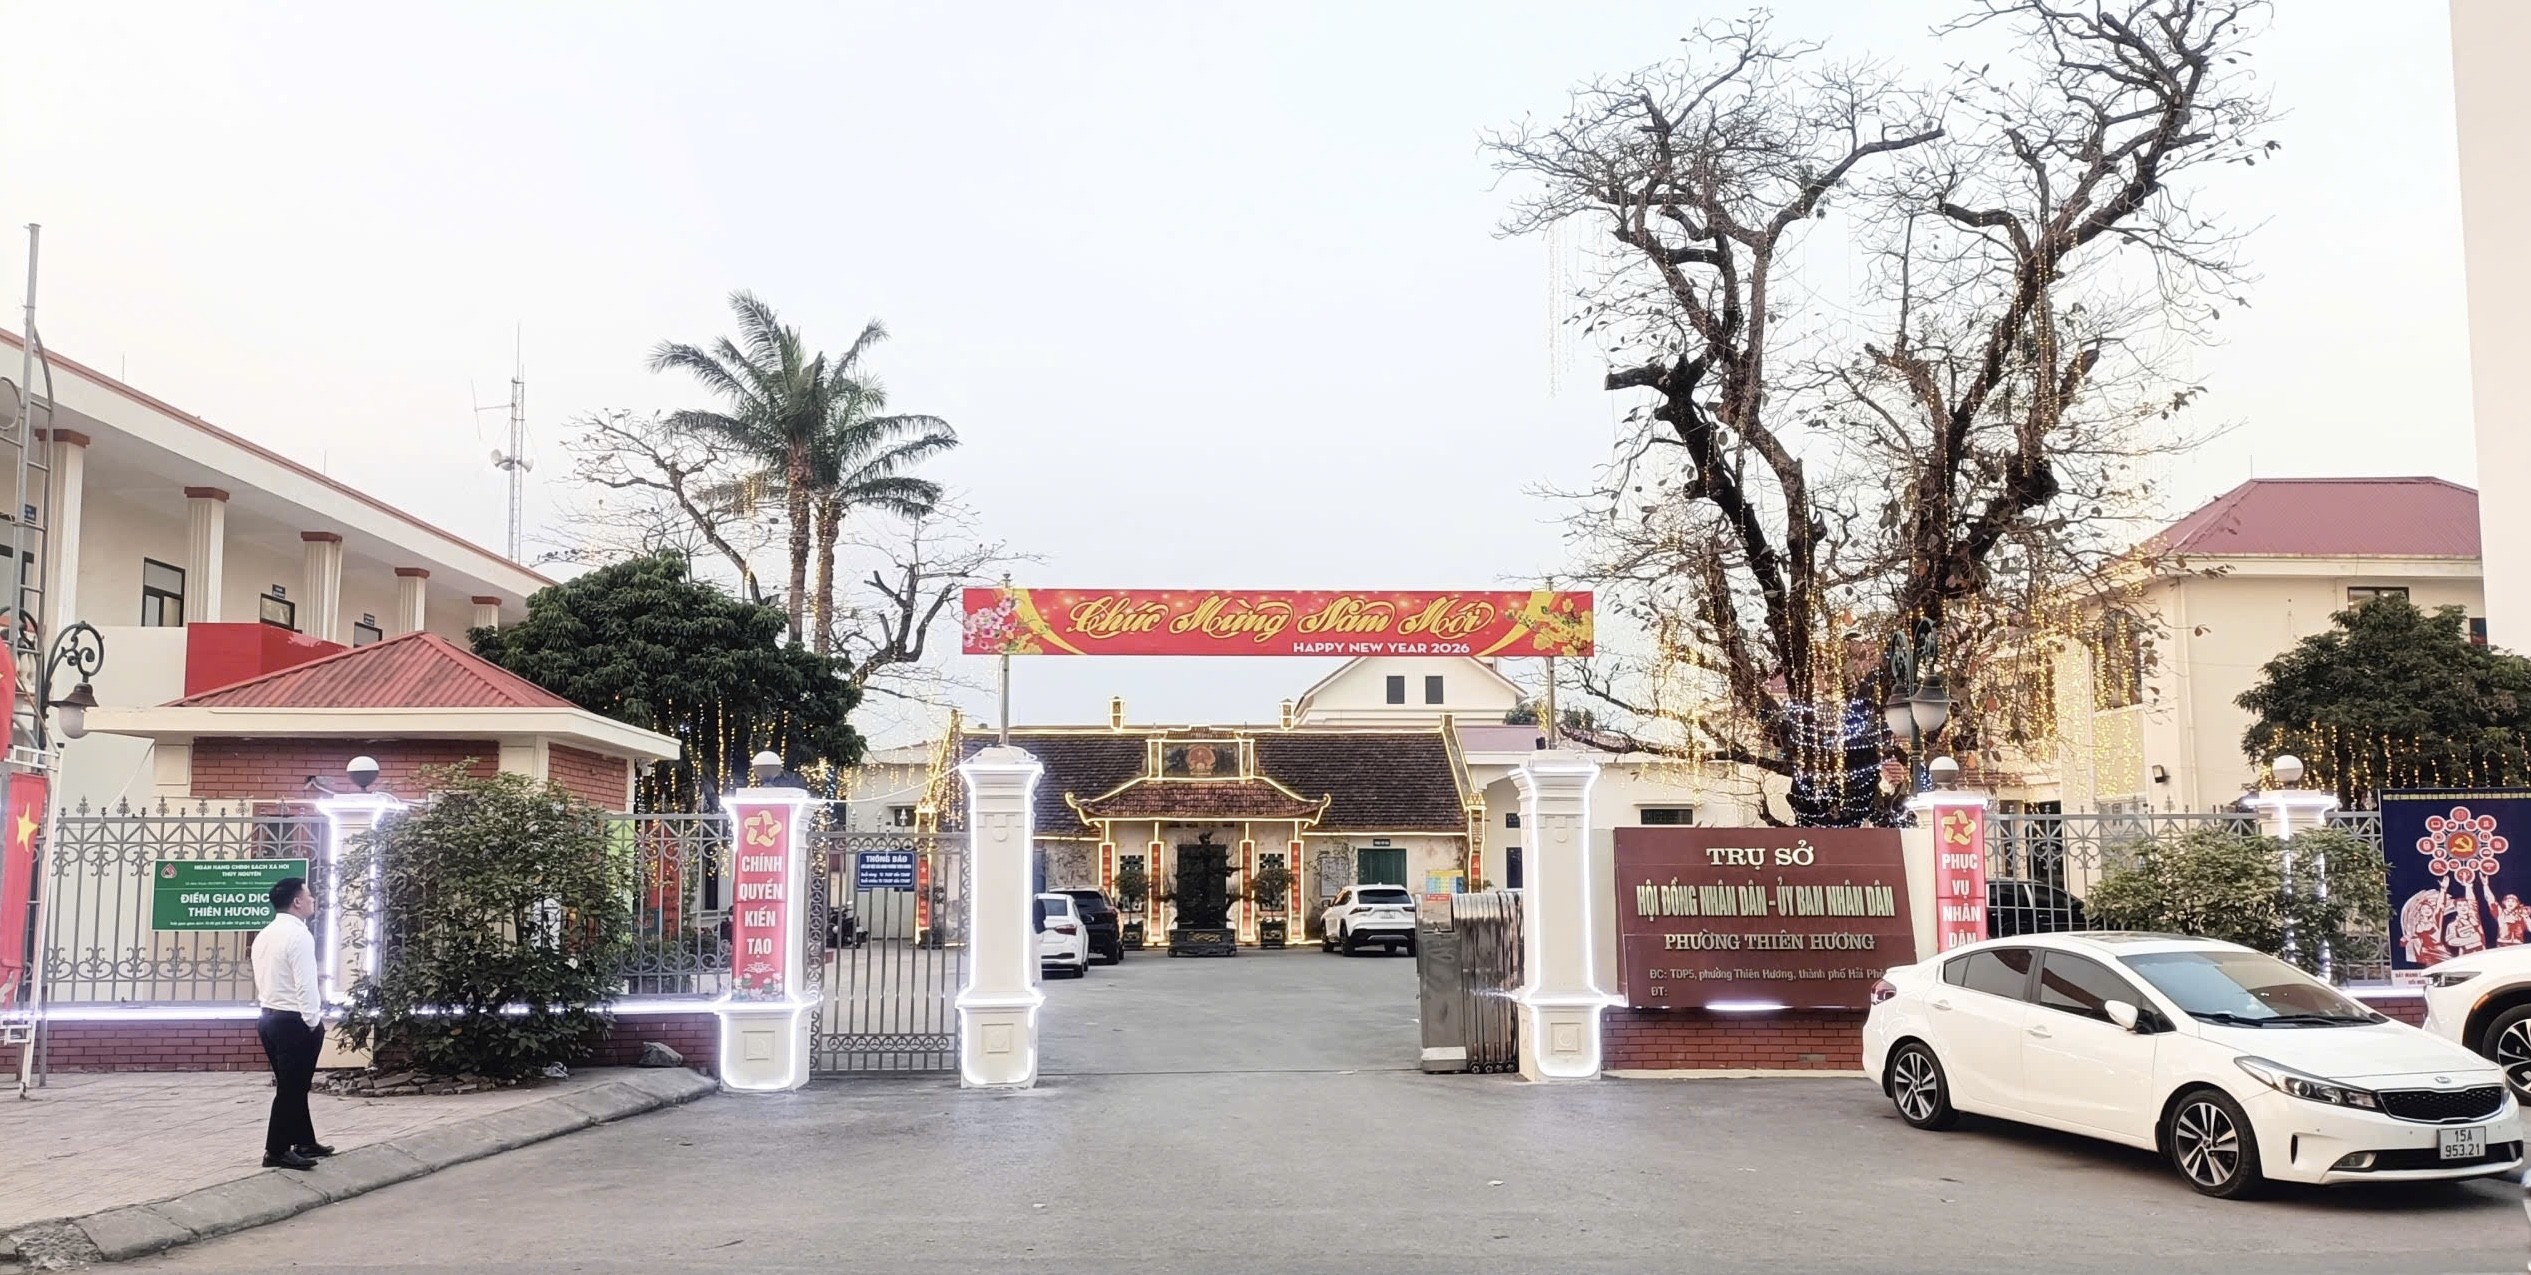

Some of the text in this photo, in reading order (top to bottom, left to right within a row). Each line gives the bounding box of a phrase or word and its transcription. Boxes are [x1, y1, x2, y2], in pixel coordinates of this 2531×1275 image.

[1065, 593, 1496, 643] Chúc Mừng Năm Mới
[1293, 642, 1470, 654] HAPPY NEW YEAR 2026
[741, 852, 782, 872] CHÍNH
[1706, 839, 1815, 870] TRỤ SỞ
[1941, 853, 1978, 873] PHỤC
[212, 893, 245, 903] GIAO
[248, 893, 270, 904] DỊC
[1636, 878, 1660, 922] HỘI
[1661, 876, 1698, 916] ĐỒNG
[1699, 879, 1738, 917] NHÂN
[1738, 879, 1768, 917] DÂN
[1776, 876, 1794, 917] ỦY
[1795, 885, 1825, 917] BAN
[1826, 879, 1865, 917] NHÂN
[1865, 879, 1896, 917] DÂN
[1951, 880, 1970, 899] VỤ
[188, 905, 270, 917] THIÊN HƯƠNG
[744, 905, 776, 928] KIẾN
[1942, 902, 1981, 922] NHÂN
[1664, 928, 1876, 950] PHƯỜNG THIÊN HƯƠNG
[1948, 928, 1977, 948] DÂN
[746, 938, 772, 959] TẠO
[1650, 966, 1885, 981] ĐC: TDP5, phường Thiên Hương, thành phố Hải Phò
[1651, 986, 1668, 997] ĐT:
[2454, 1129, 2473, 1143] 15A
[2445, 1143, 2480, 1157] 953.21
